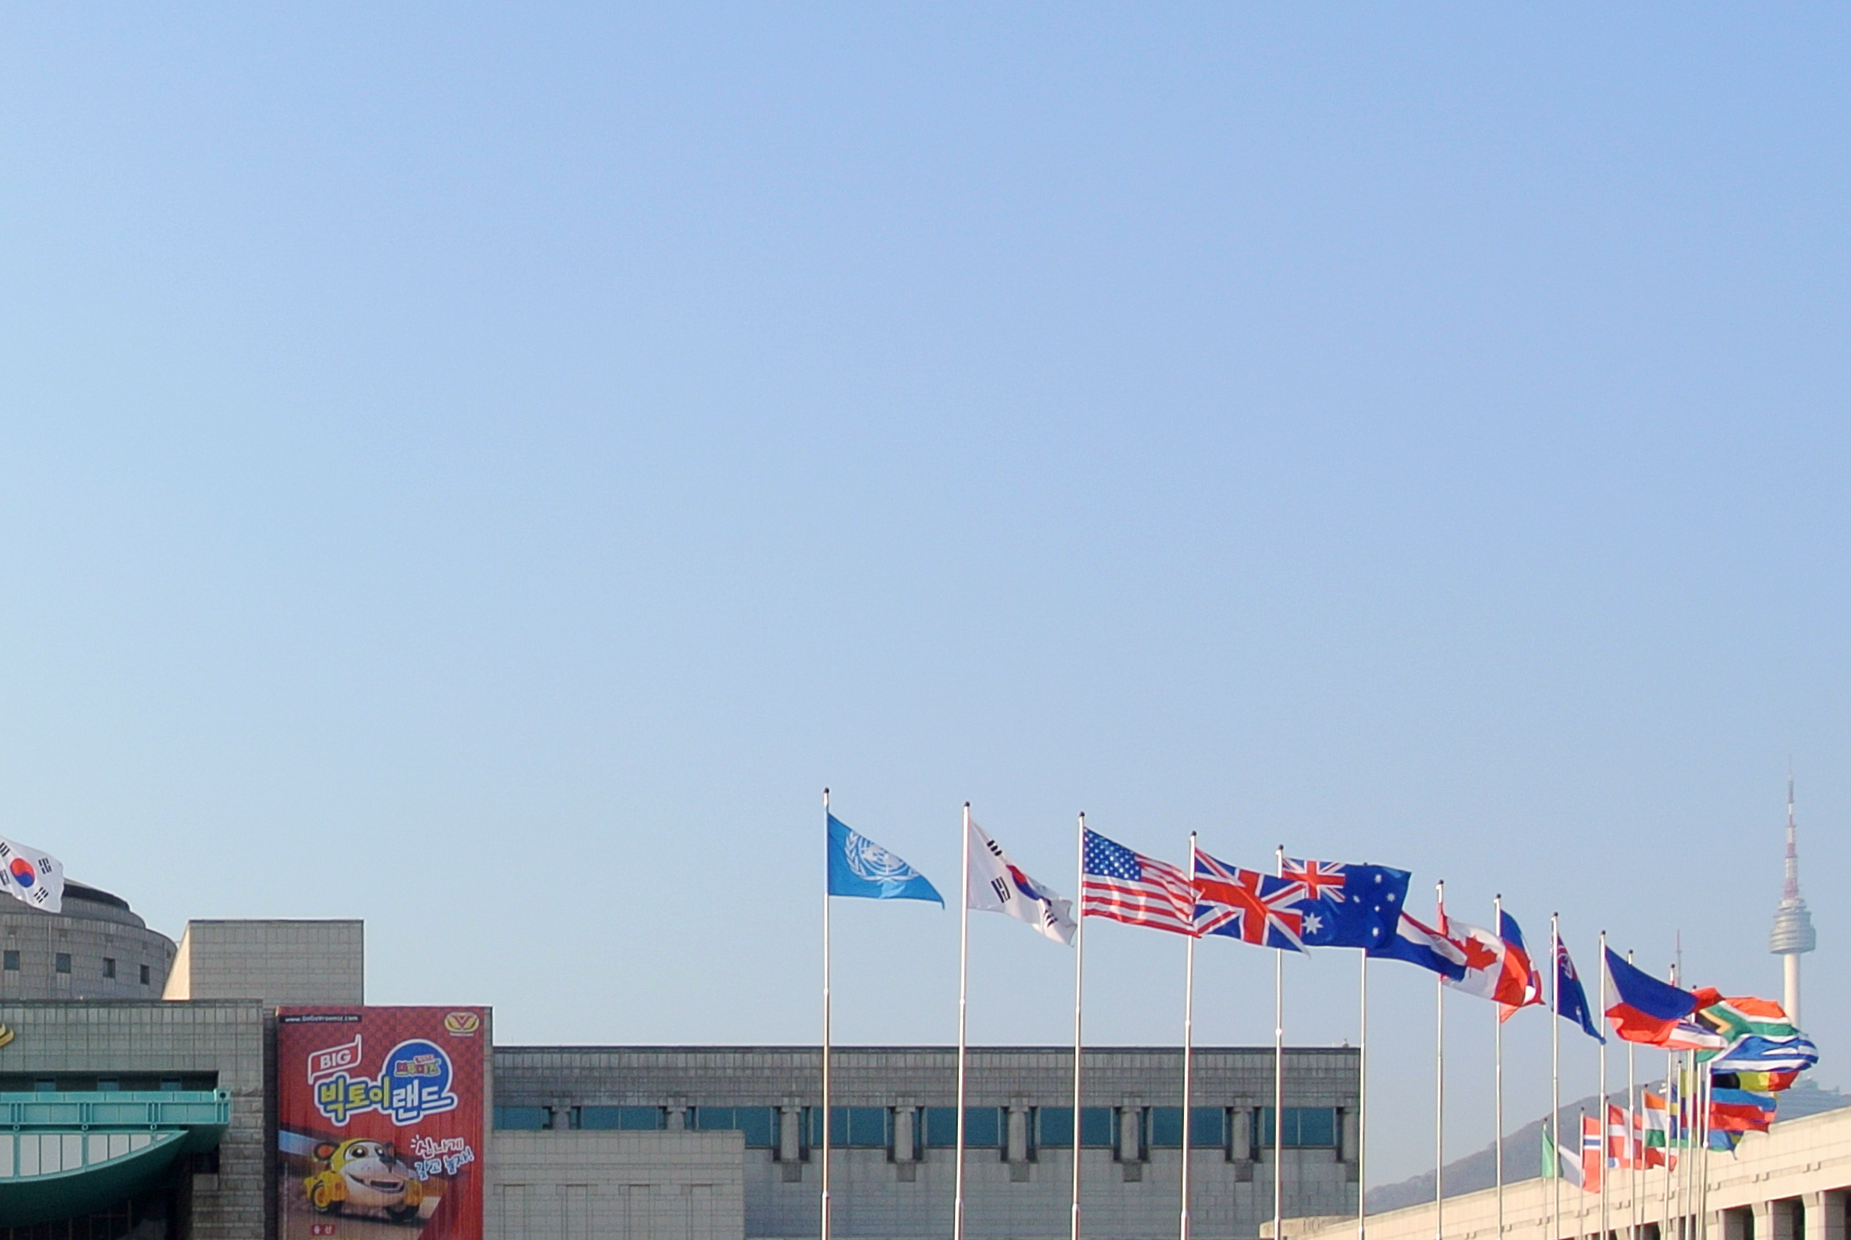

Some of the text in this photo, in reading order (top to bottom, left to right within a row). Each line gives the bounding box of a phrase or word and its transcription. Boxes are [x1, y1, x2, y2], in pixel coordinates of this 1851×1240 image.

[320, 1049, 352, 1070] BIG
[320, 1076, 452, 1120] 빅토이랜드
[415, 1136, 464, 1159] 신나게
[414, 1145, 475, 1180] 갖고 놀자!
